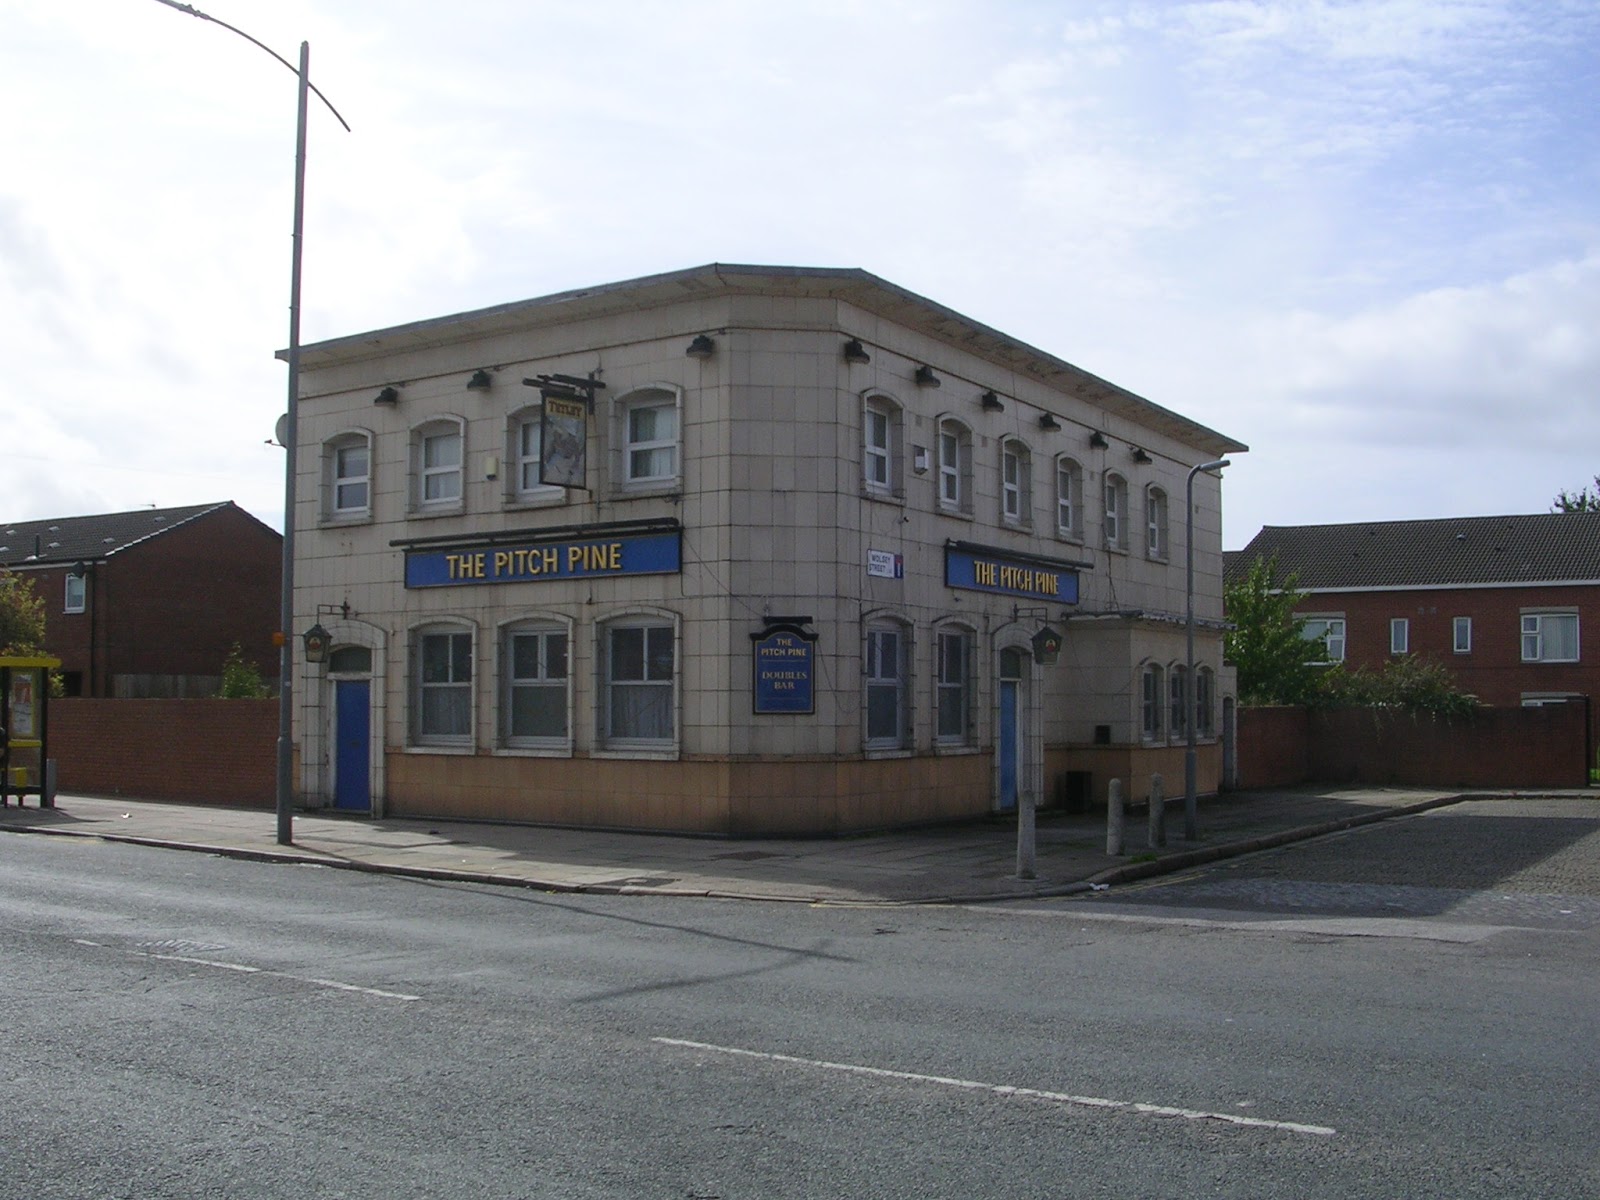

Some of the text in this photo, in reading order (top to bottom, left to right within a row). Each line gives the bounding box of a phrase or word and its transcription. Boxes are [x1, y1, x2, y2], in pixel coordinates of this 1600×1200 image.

[446, 543, 622, 579] THE PITCH PINE
[974, 560, 1059, 595] THE PITCH PINE
[776, 638, 792, 647] THE
[761, 647, 806, 656] PITCH PINE
[762, 671, 807, 679] DOUBLES
[774, 681, 795, 689] BAR
